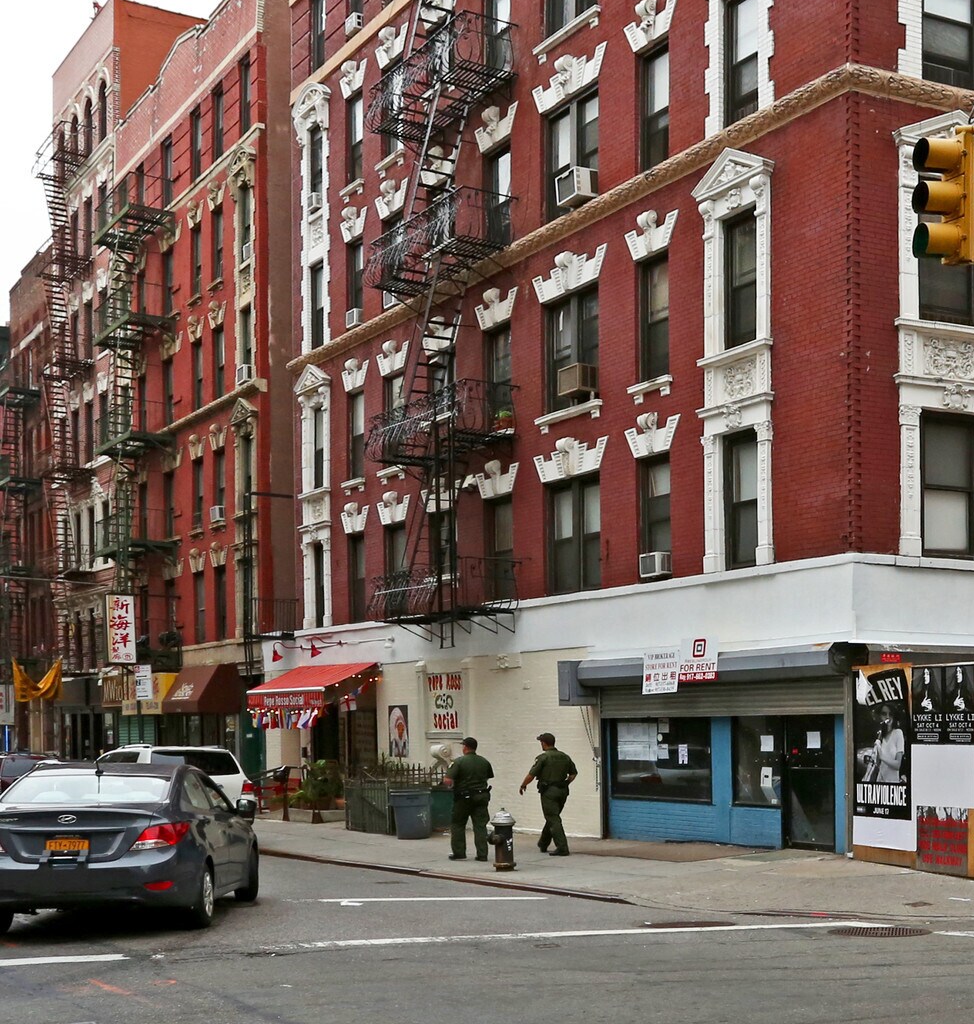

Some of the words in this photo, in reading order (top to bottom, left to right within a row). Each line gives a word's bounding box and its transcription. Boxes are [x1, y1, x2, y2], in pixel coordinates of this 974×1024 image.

[680, 664, 694, 672] FOR
[696, 663, 716, 671] RENT
[877, 676, 903, 702] REY
[913, 714, 932, 722] LYKKE
[934, 714, 942, 722] LI
[945, 713, 965, 721] LYKKE
[967, 713, 974, 721] LI
[856, 783, 907, 807] ULTRAVIOLENCE
[873, 807, 884, 815] JUNE
